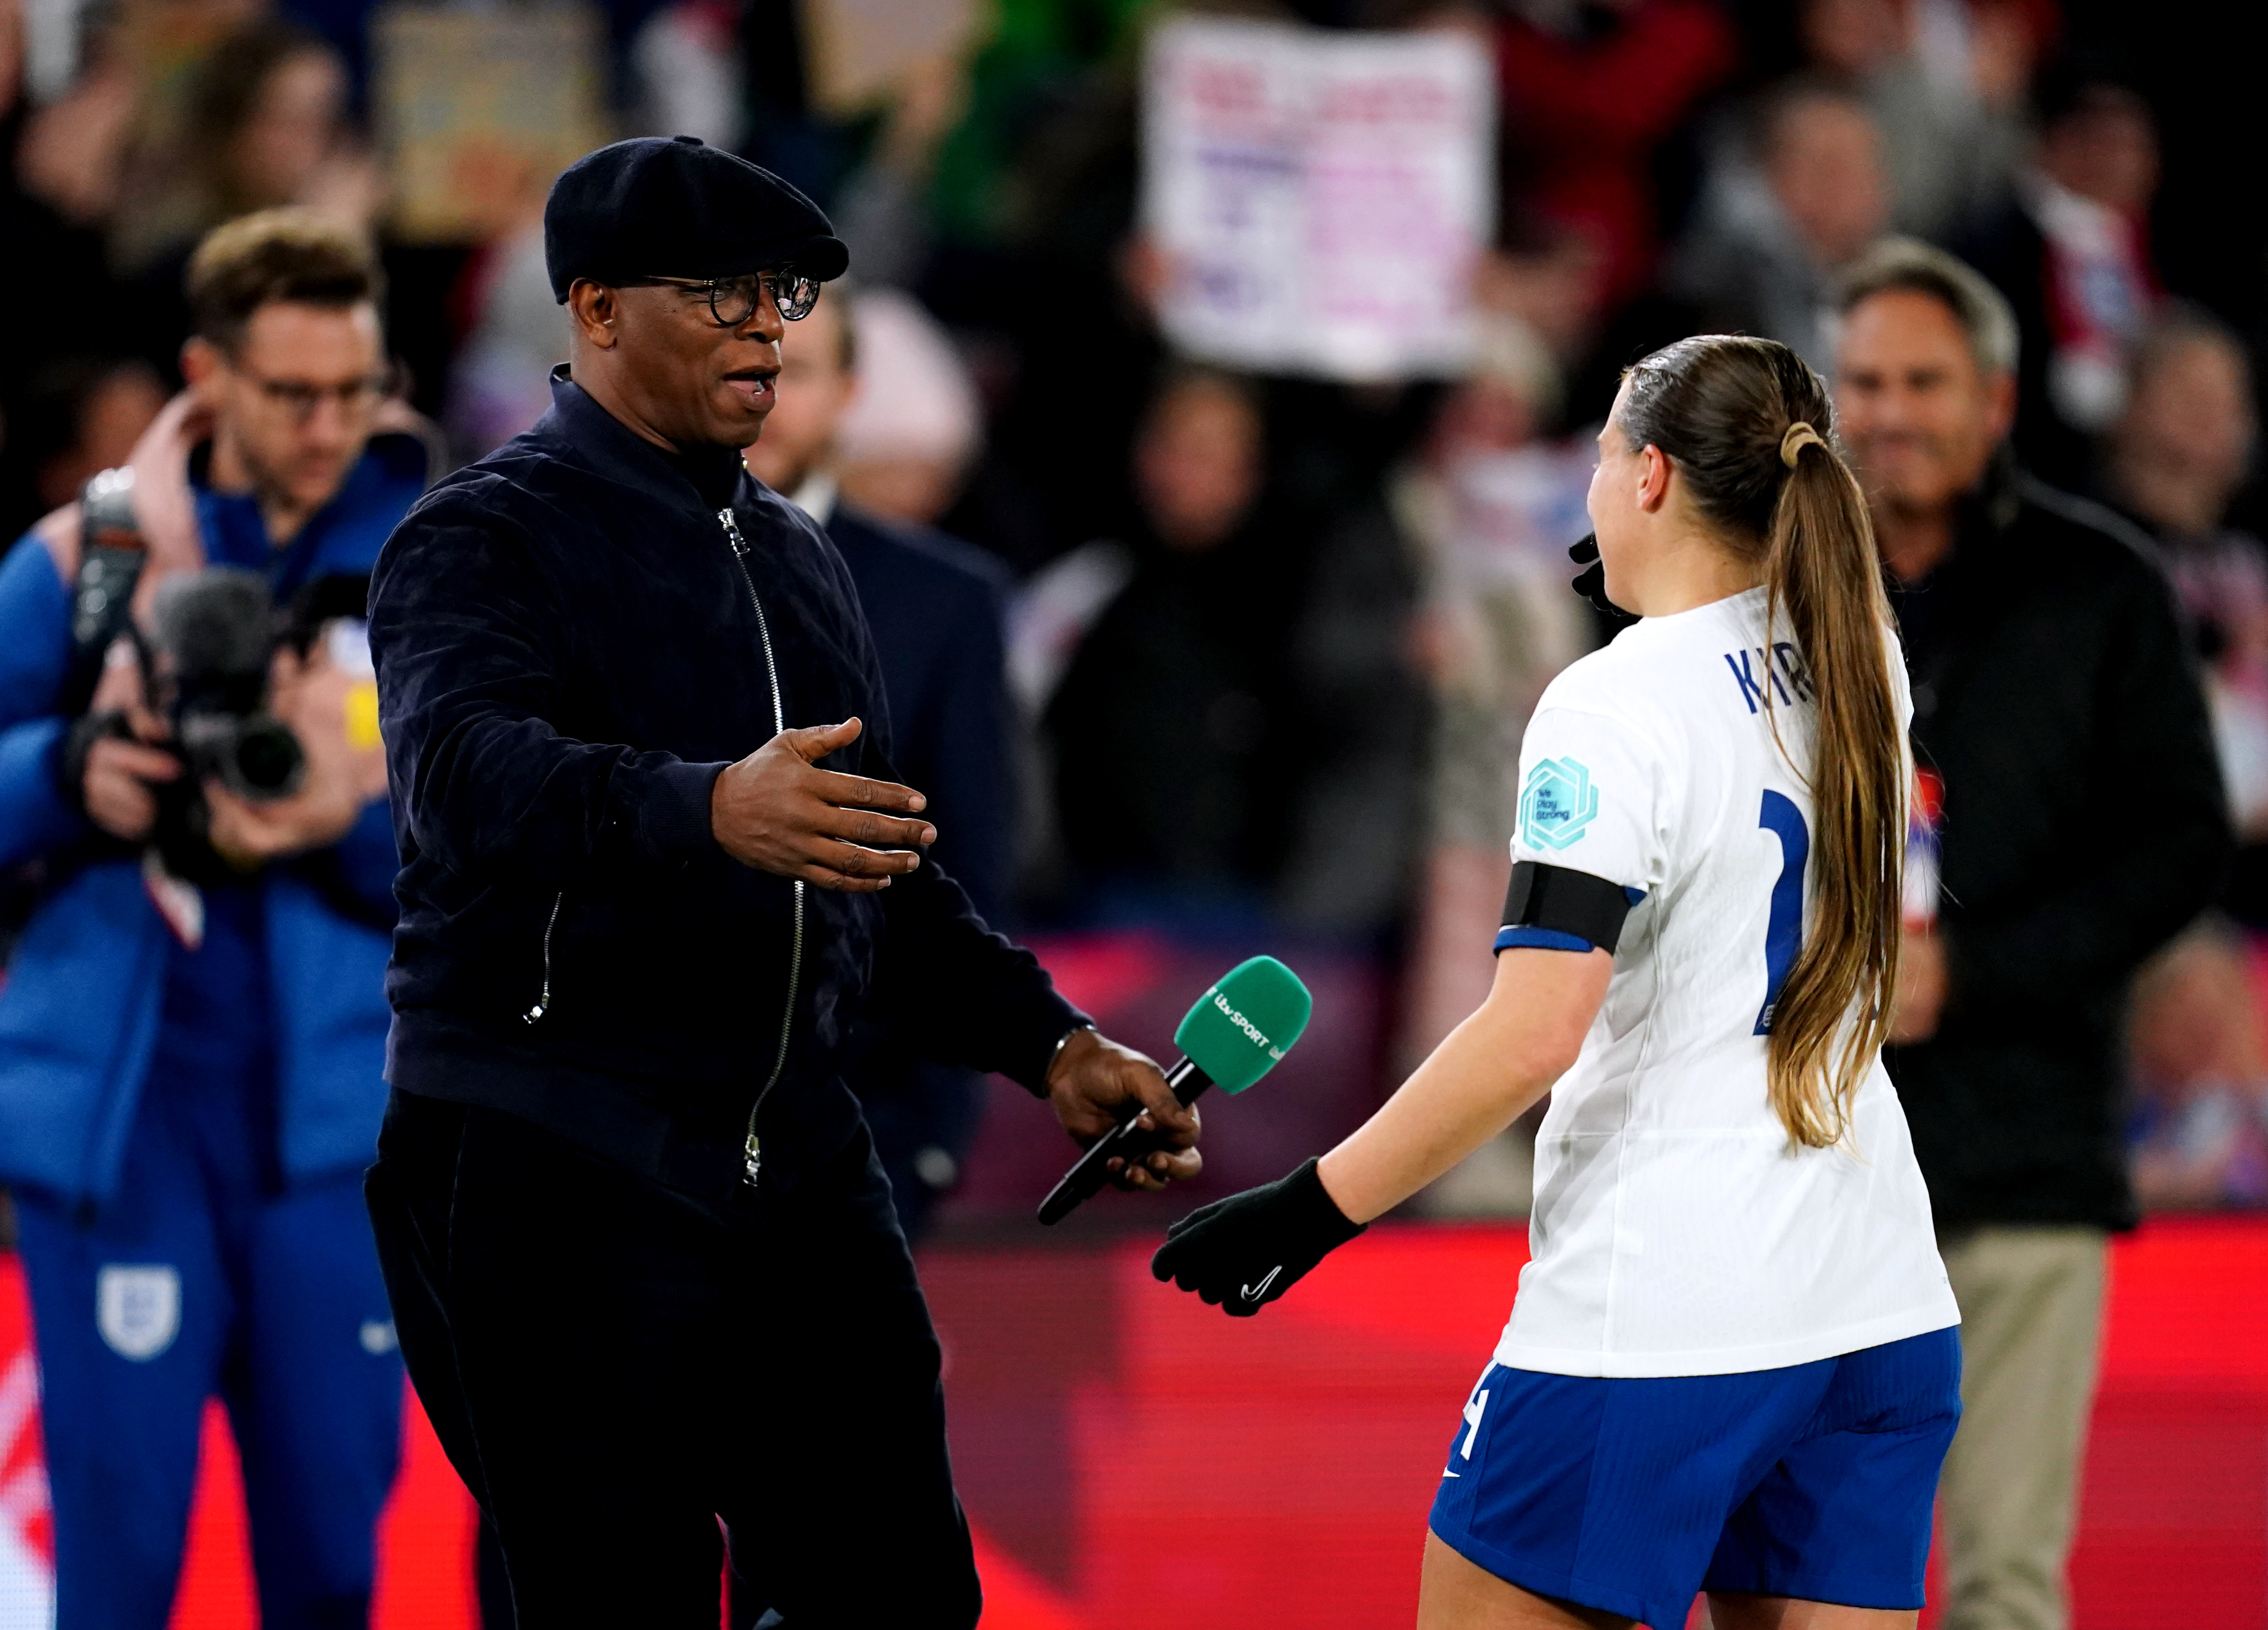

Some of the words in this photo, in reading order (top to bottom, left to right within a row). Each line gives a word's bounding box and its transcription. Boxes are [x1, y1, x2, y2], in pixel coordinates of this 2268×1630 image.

[1537, 799, 1557, 811] Play
[1536, 810, 1569, 821] Strong
[1214, 993, 1234, 1015] itv
[1230, 1011, 1270, 1047] SPORT
